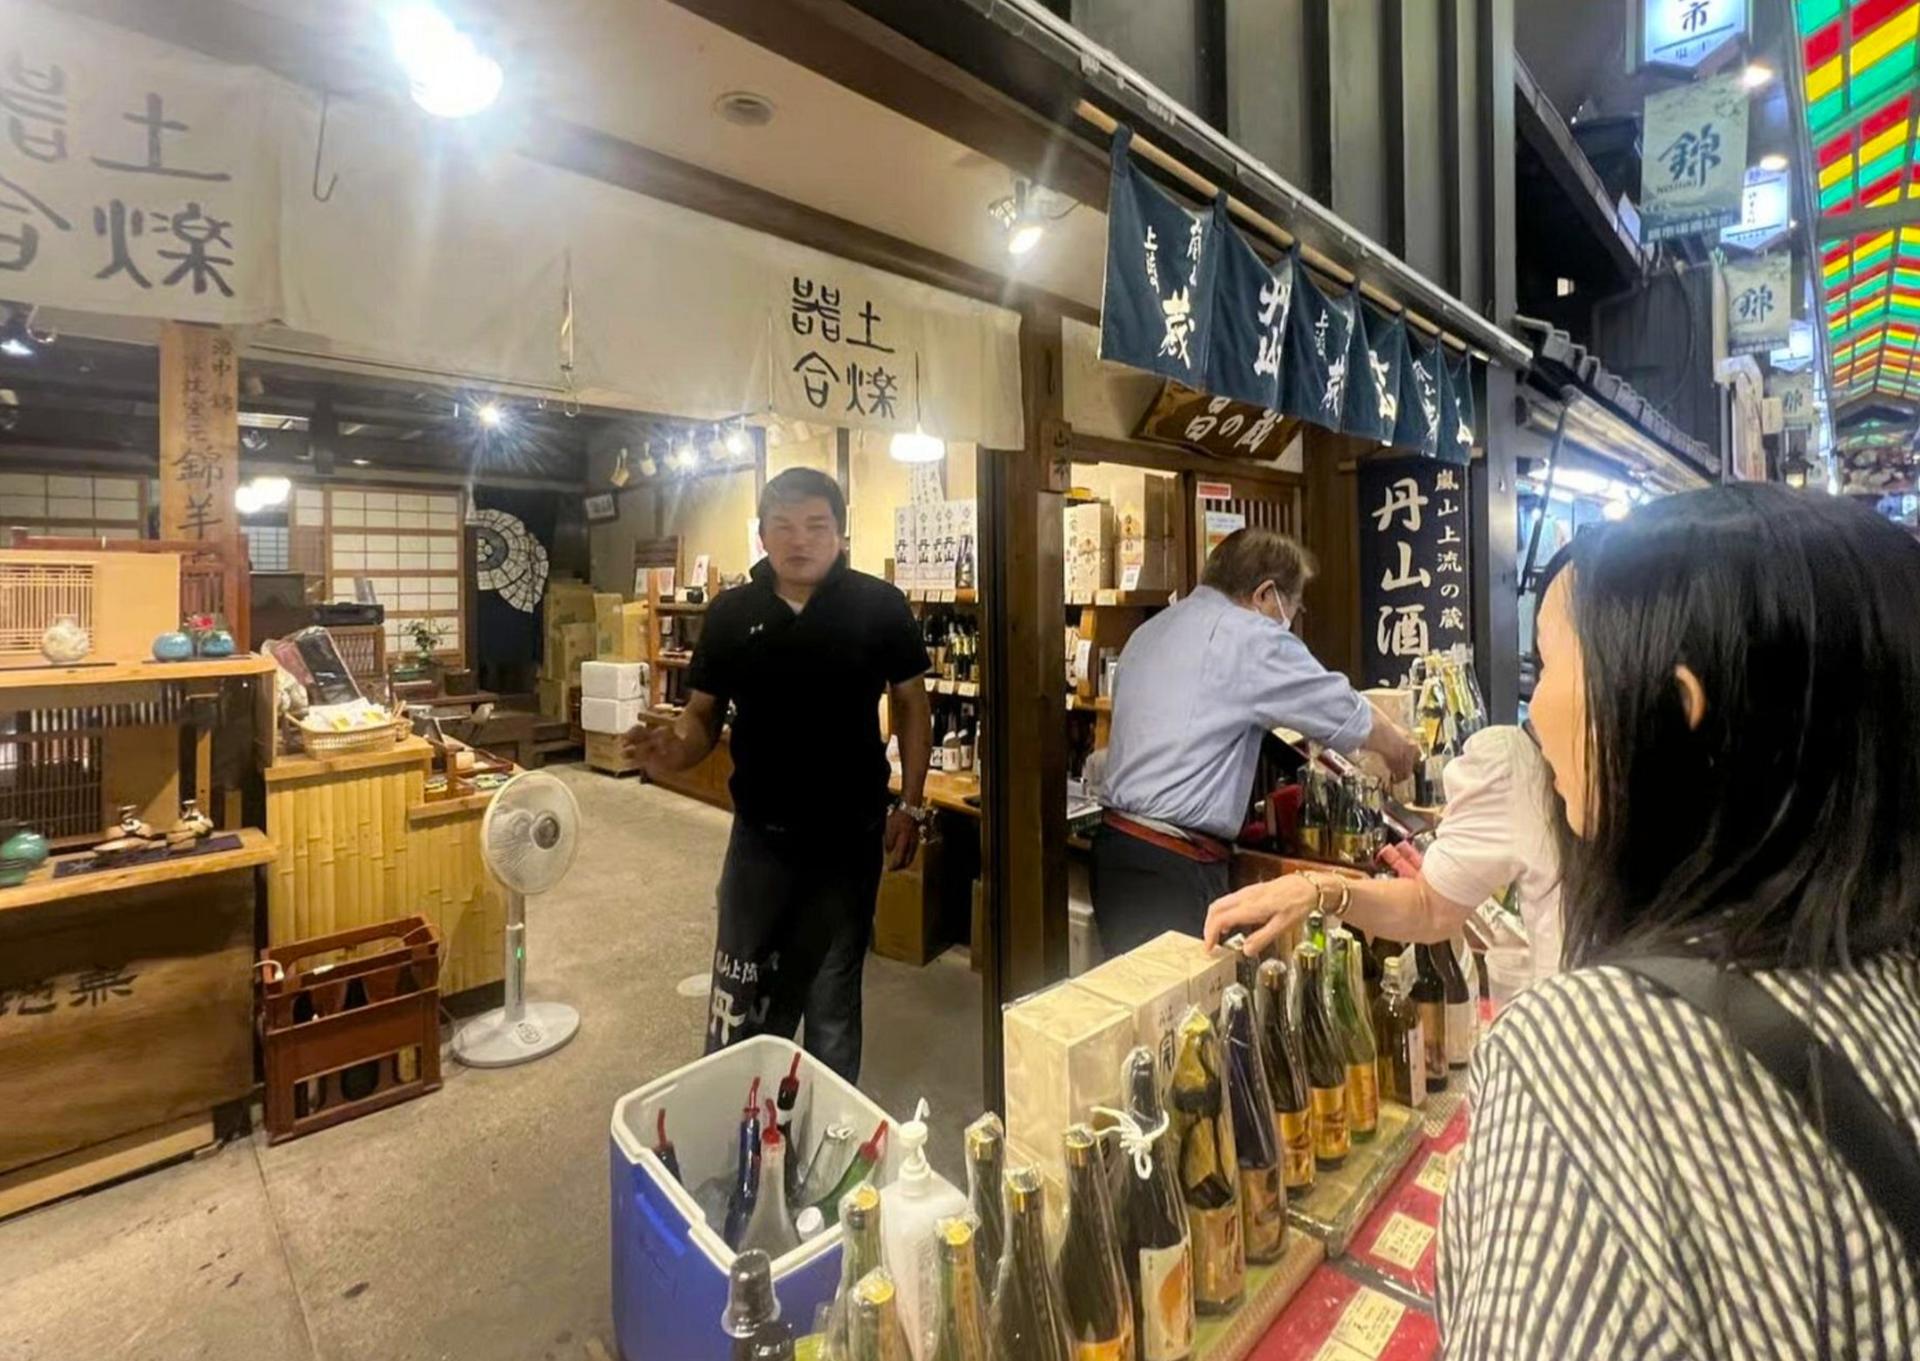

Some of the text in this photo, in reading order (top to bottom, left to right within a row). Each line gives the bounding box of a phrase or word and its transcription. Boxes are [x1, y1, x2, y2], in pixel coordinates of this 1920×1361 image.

[1657, 122, 1723, 188] 錦
[1434, 469, 1465, 631] 嵐山上流の蔵
